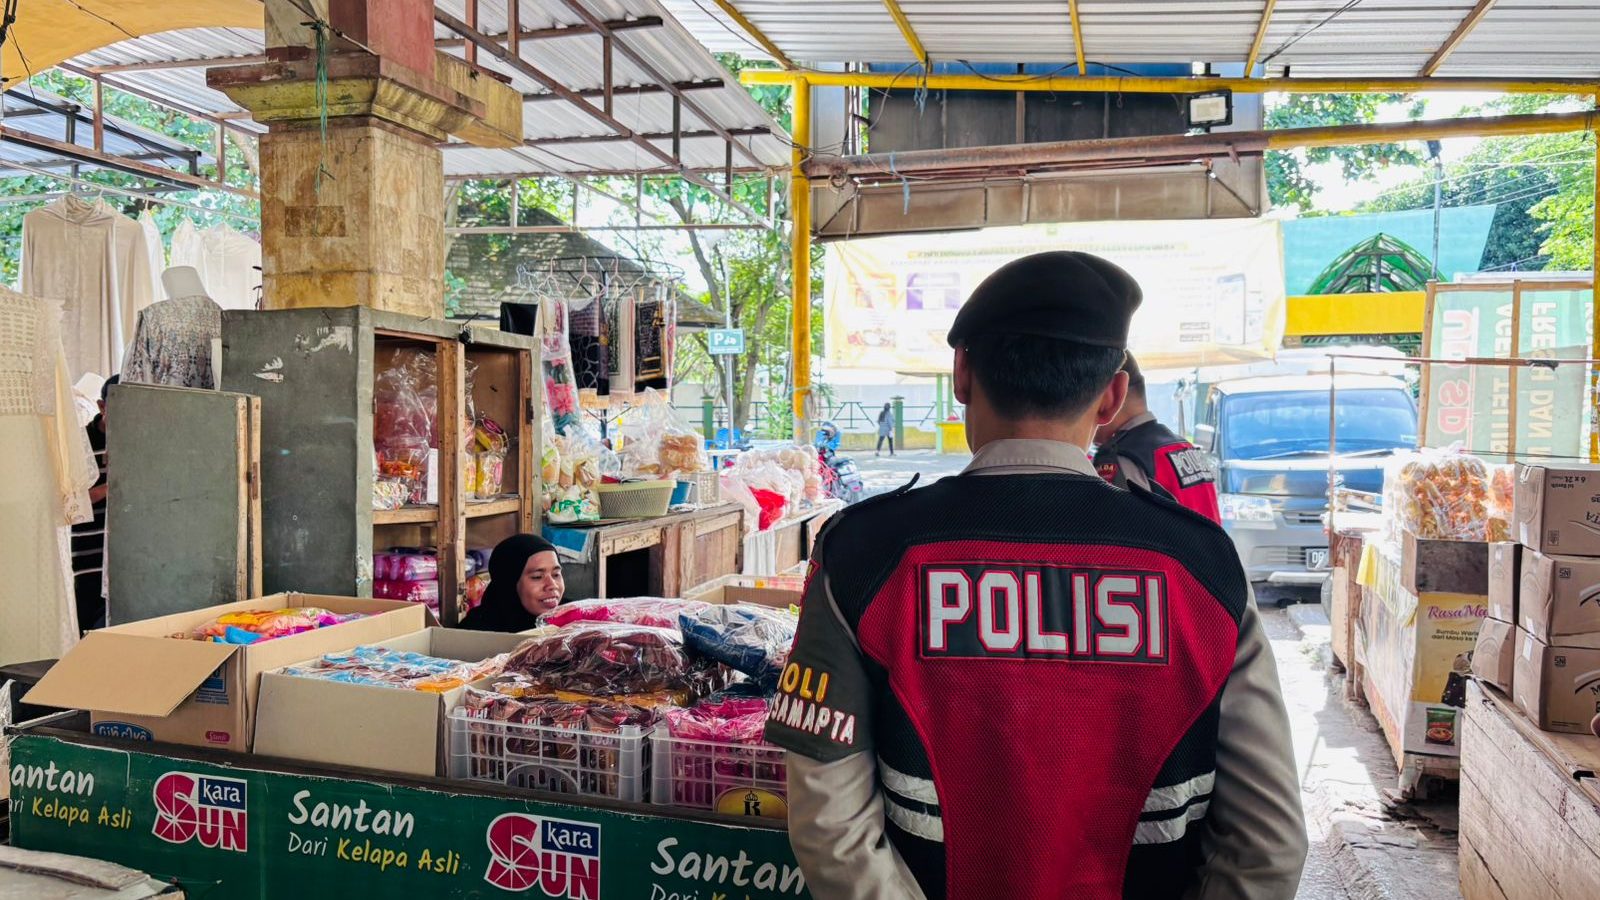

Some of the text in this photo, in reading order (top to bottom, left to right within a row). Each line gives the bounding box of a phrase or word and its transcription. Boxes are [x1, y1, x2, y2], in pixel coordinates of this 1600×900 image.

[926, 568, 1164, 658] POLISI
[777, 662, 830, 703] OLI
[770, 692, 856, 745] SAMAPTA
[10, 760, 94, 796] antan
[203, 779, 241, 804] kara
[32, 797, 89, 827] Kelapa
[98, 805, 133, 829] Asli
[152, 771, 247, 852] SUN
[288, 789, 415, 839] Santan
[288, 831, 461, 875] Dari Kelapa Asli
[484, 812, 601, 900] SUN
[547, 822, 593, 849] kara
[650, 837, 806, 896] Santan
